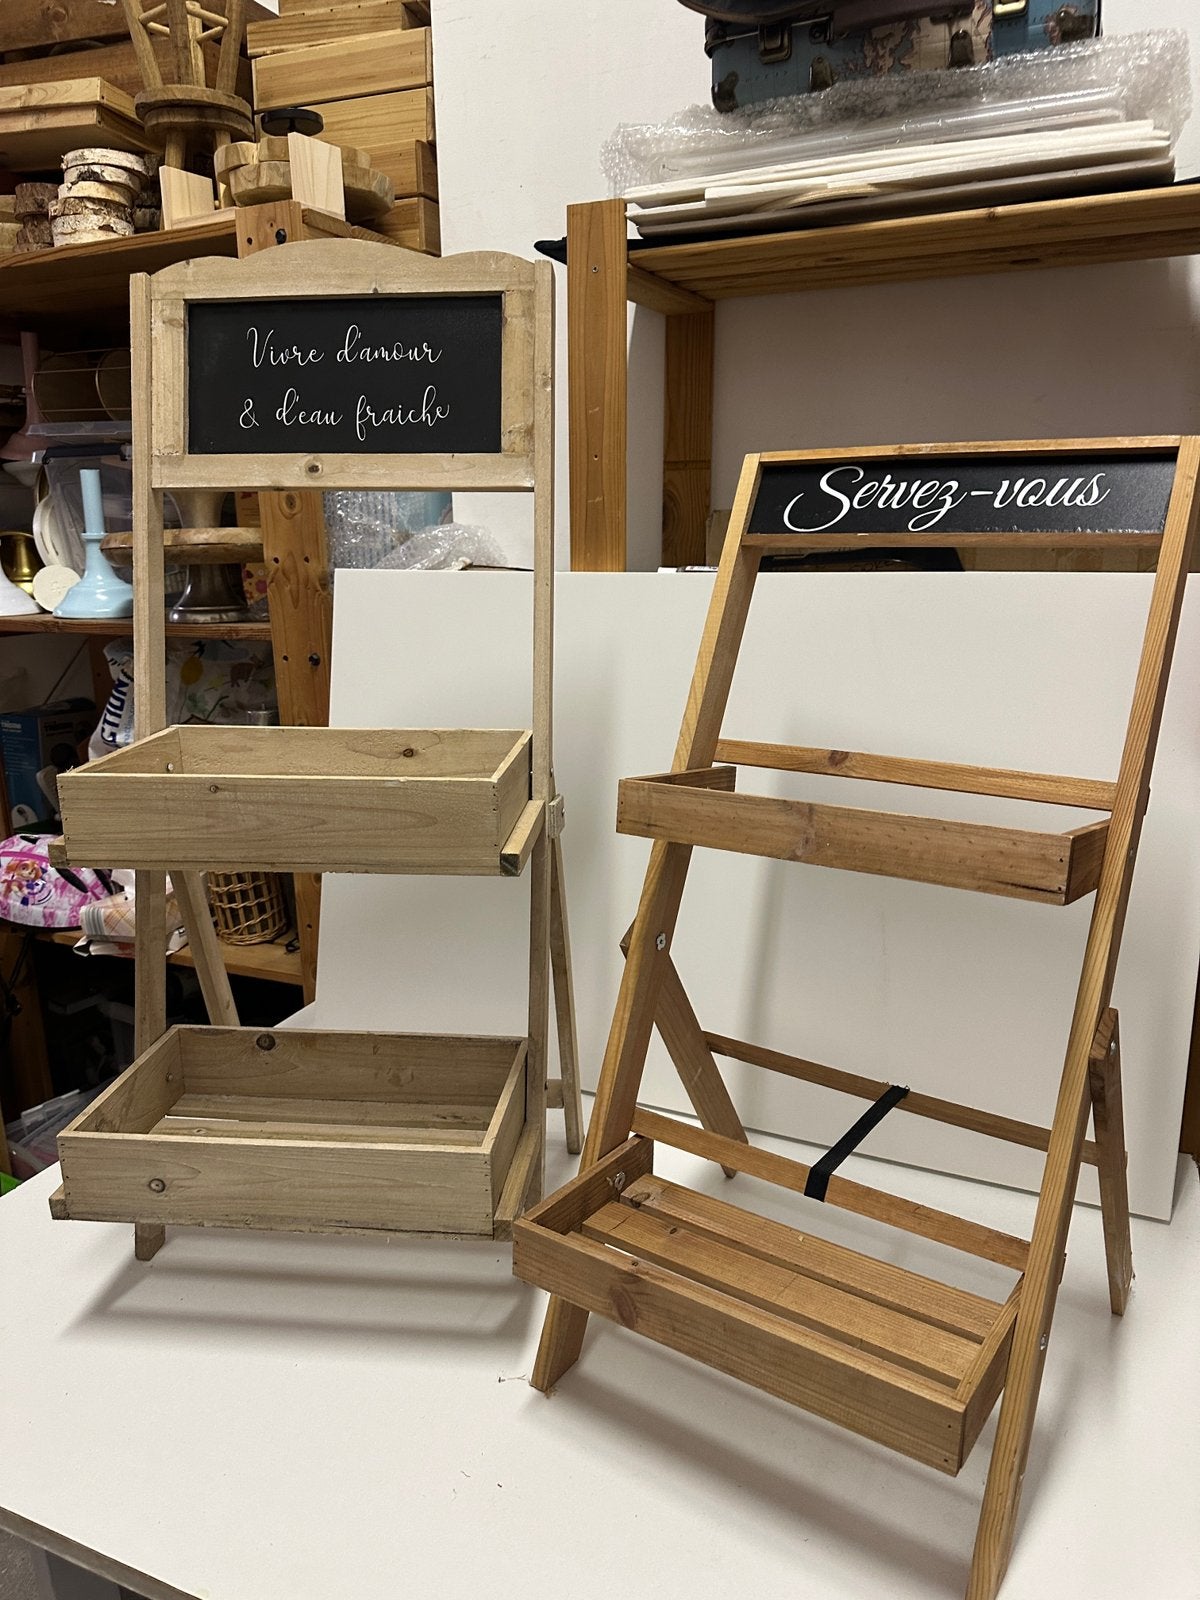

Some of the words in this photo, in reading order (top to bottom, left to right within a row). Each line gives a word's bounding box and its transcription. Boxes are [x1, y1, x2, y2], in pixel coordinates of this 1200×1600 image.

[246, 326, 325, 368] Vivre
[336, 324, 442, 363] d'amour
[239, 398, 260, 429] &
[275, 387, 343, 426] d'eau
[356, 385, 450, 441] fraiche
[783, 465, 1110, 532] Servez-vous
